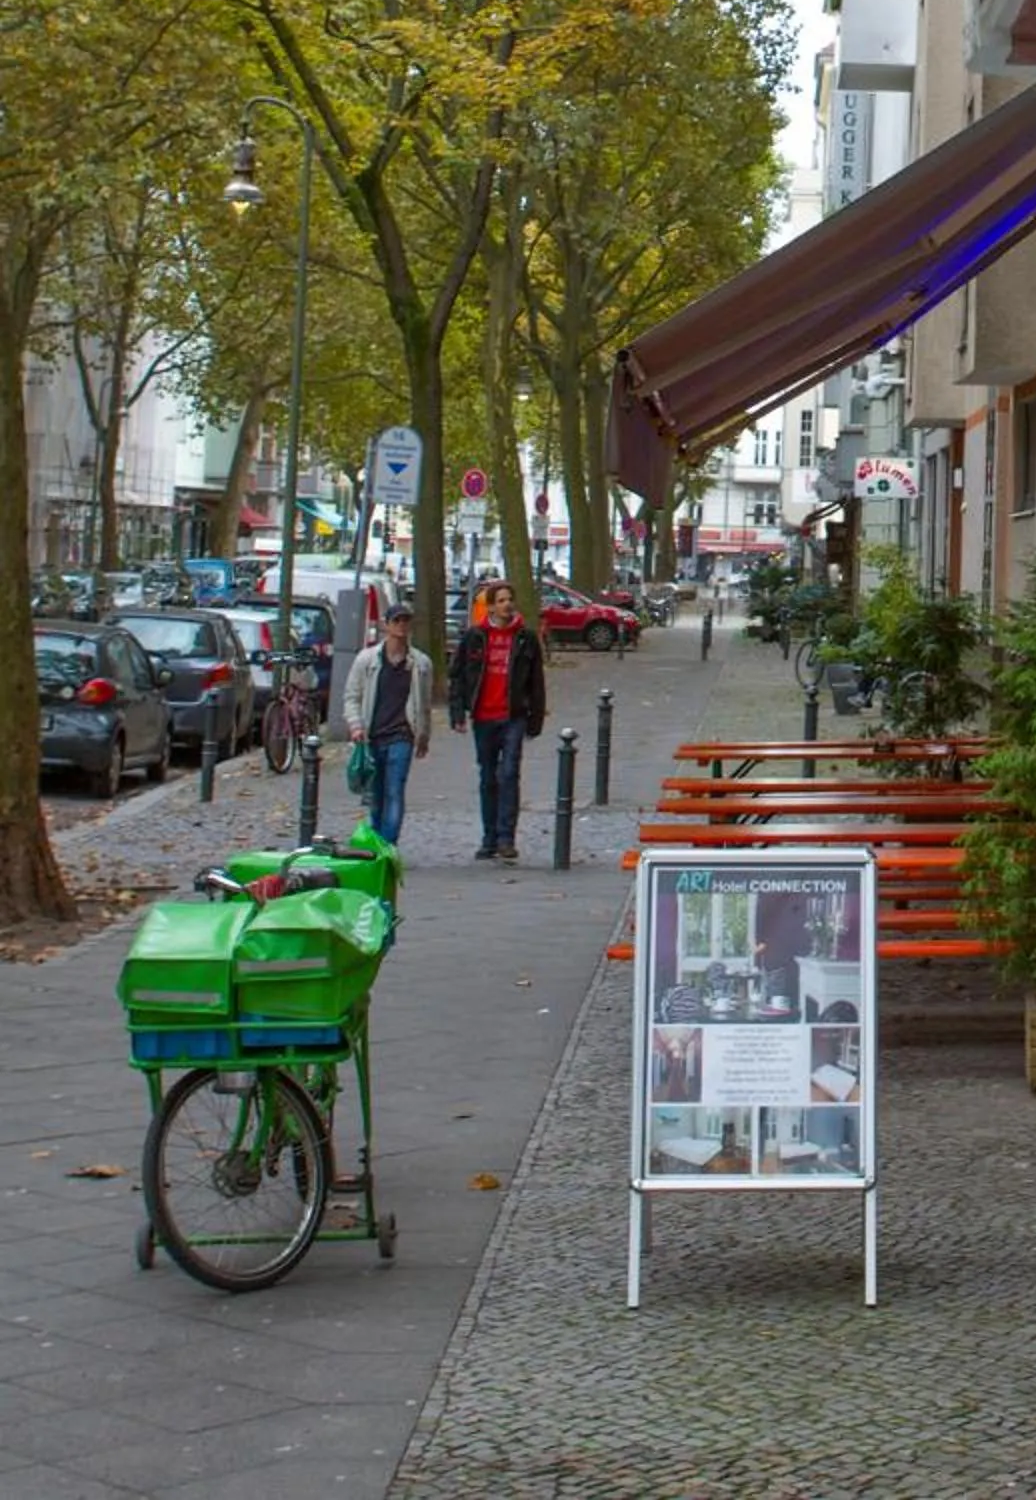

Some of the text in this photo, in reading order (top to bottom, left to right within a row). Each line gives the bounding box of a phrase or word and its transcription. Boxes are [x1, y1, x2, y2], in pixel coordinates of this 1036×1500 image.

[841, 94, 858, 181] UGGER
[676, 870, 847, 893] ART Hotel CONNECTION
